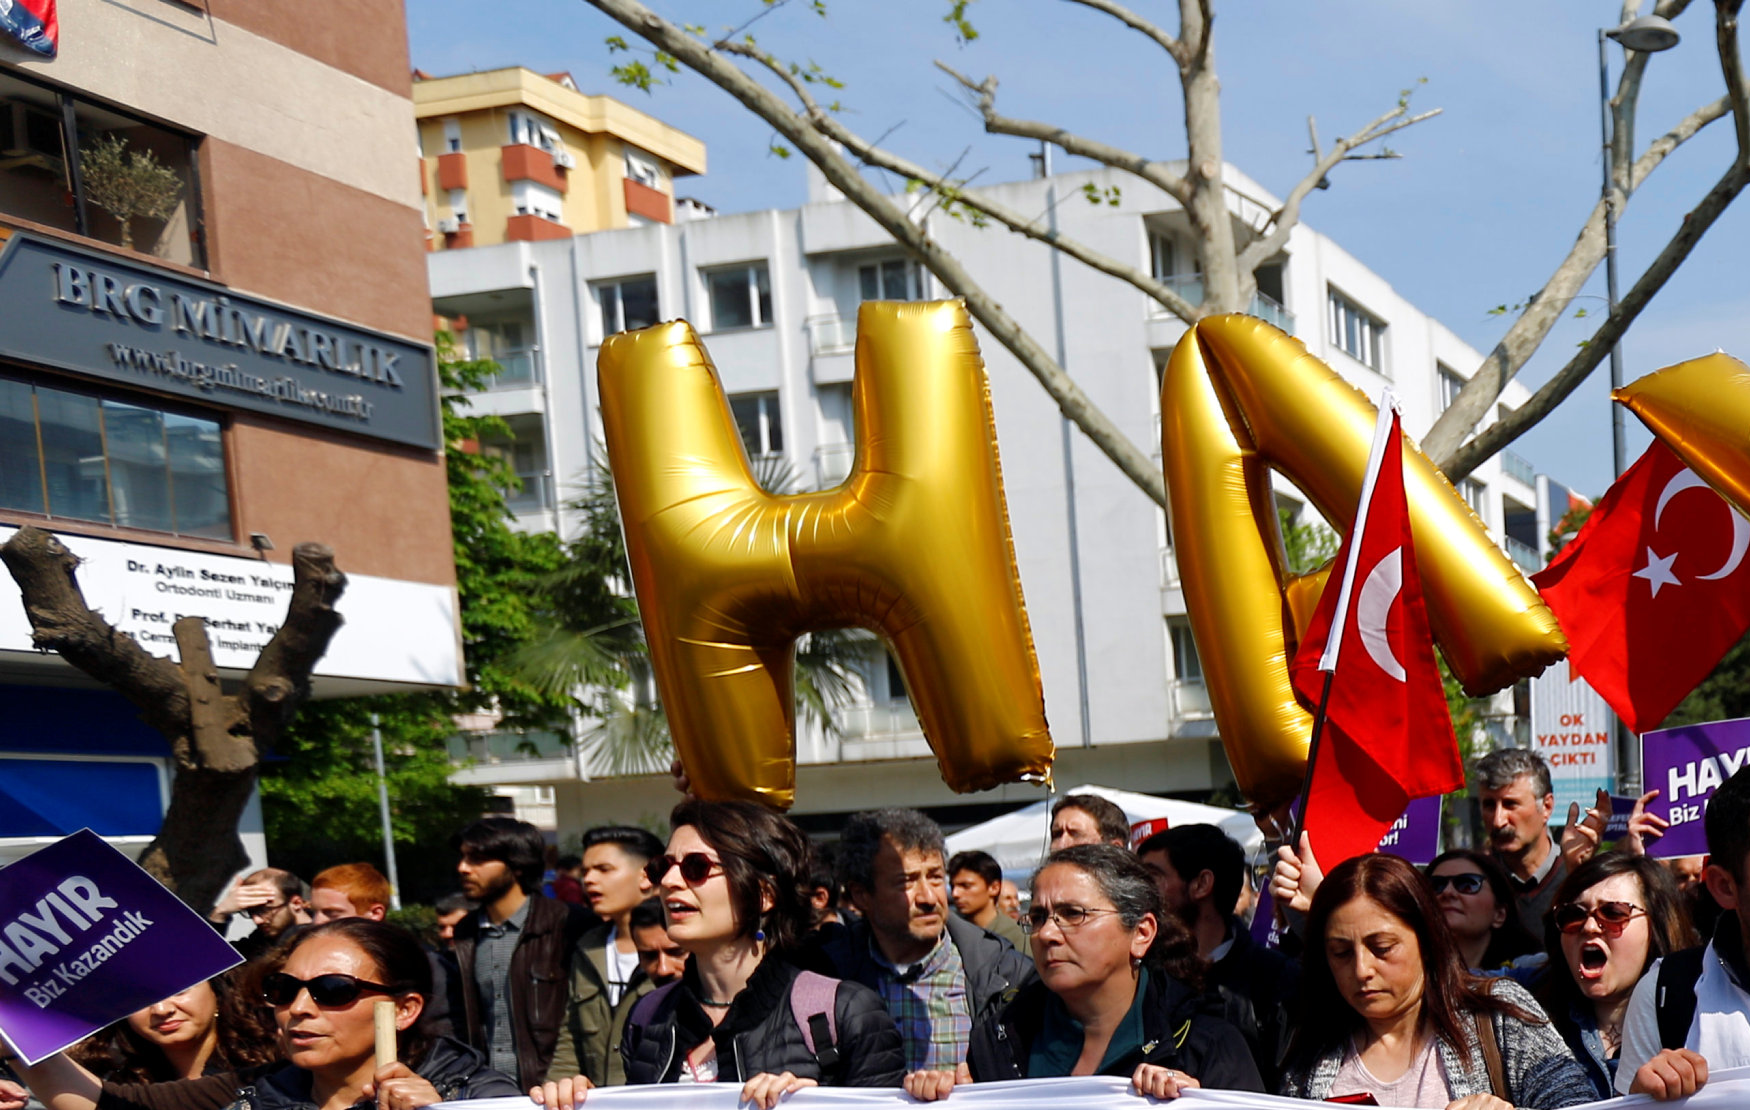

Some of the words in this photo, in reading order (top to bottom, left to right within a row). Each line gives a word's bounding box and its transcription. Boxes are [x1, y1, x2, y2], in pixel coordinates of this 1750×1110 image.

[53, 262, 164, 325] BRG
[171, 294, 404, 388] MİMARLIK
[127, 560, 150, 574] Dr.
[155, 564, 195, 580] Aylin
[200, 569, 246, 585] Sezen
[155, 582, 222, 599] Ortodonti
[131, 608, 169, 624] Prof.
[1560, 713, 1584, 728] OK
[1537, 732, 1608, 747] YAYDAN
[1549, 752, 1596, 768] ÇIKTI
[1669, 804, 1700, 827] Biz
[24, 979, 67, 1009] Biz
[52, 910, 154, 986] Kazandık
